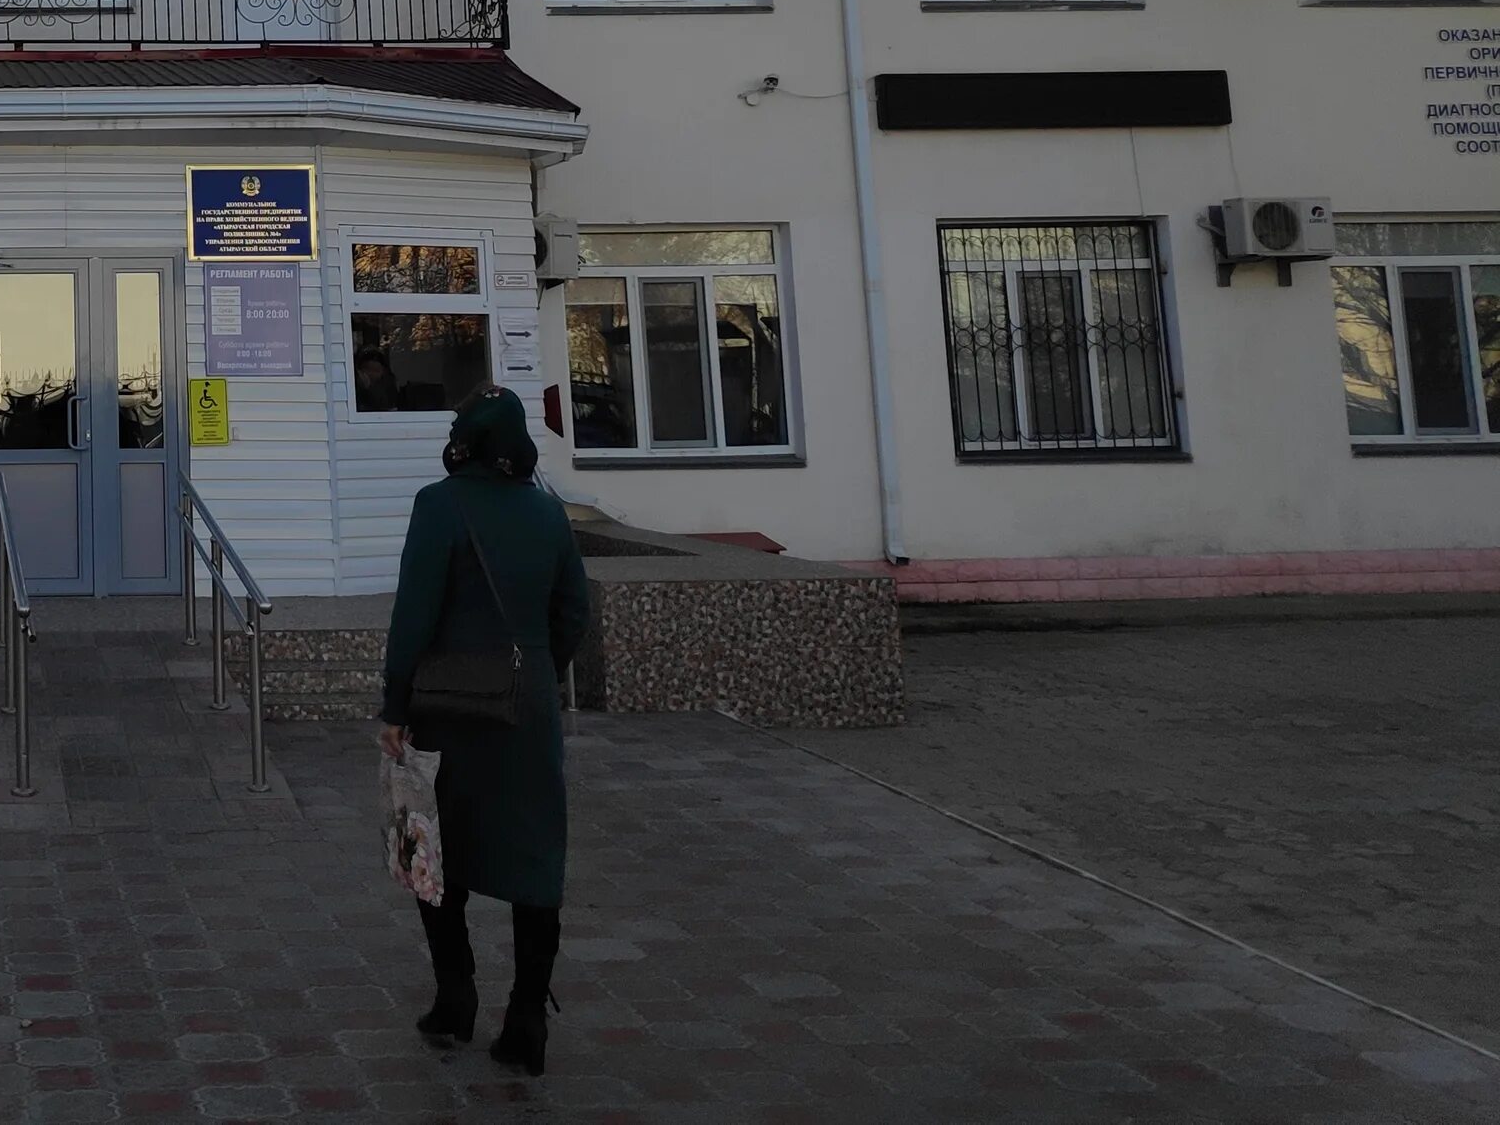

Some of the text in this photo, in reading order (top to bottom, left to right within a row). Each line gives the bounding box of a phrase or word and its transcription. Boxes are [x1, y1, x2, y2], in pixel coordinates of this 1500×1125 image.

[1424, 66, 1500, 80] ПЕРВИЧН
[210, 269, 293, 279] РЕГЛАМЕНТ РАБОТЫ
